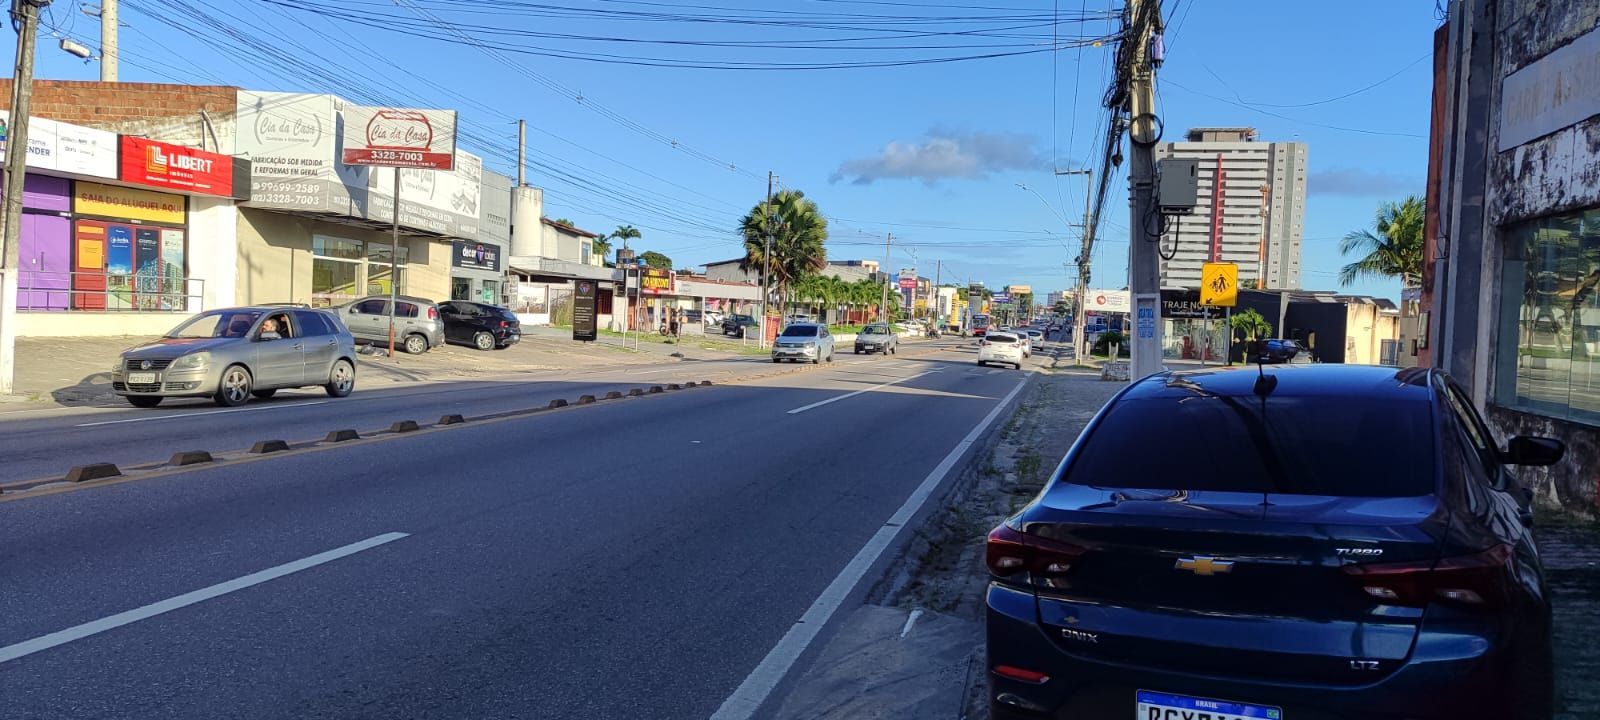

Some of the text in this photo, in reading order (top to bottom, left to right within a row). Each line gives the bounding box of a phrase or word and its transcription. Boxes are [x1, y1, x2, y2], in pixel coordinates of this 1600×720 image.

[260, 116, 316, 136] Cia da Casa
[371, 124, 428, 143] Cia da Casa
[251, 155, 286, 166] FABRICAÇÃO
[371, 151, 423, 161] 3328-7003
[169, 153, 213, 173] LIBERT
[259, 166, 289, 175] REFORMAS
[300, 168, 318, 176] GERAL
[260, 182, 320, 193] 99699-2589
[81, 193, 183, 214] SAIA DO ALUGUEL AQUI
[1163, 300, 1188, 309] TRAJE
[1062, 629, 1098, 643] ONIX
[1350, 660, 1379, 670] LTZ
[1195, 700, 1219, 709] BRASIL
